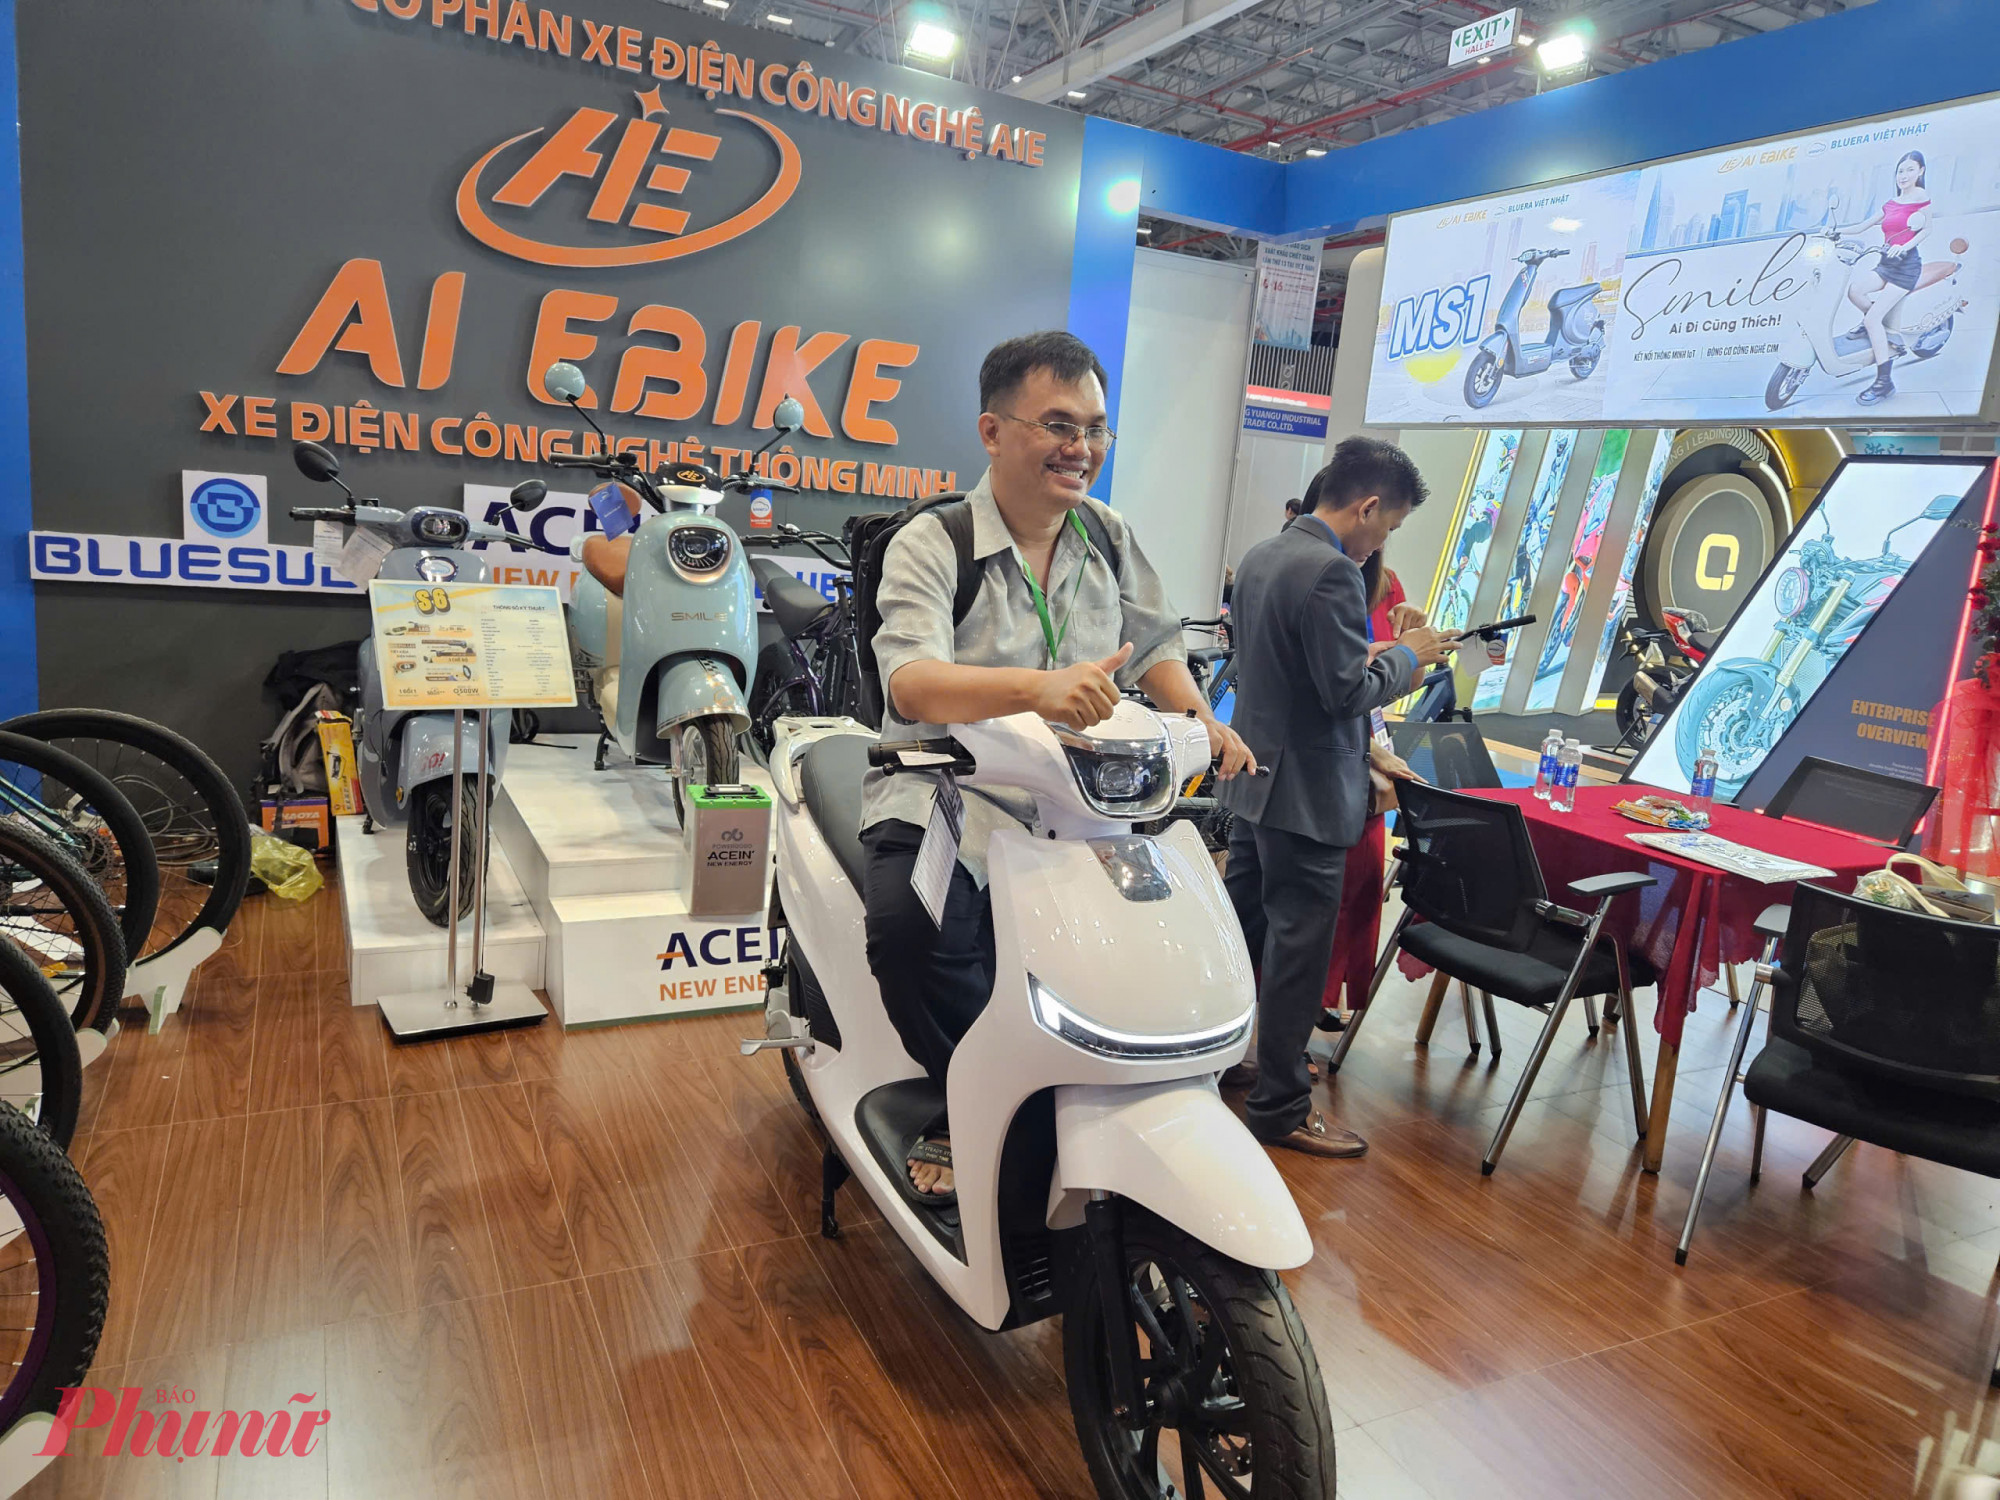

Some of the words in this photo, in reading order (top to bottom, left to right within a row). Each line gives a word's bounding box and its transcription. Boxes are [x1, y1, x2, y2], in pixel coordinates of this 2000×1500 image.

[1462, 17, 1502, 47] EXIT
[1465, 43, 1483, 55] HALL
[1485, 39, 1495, 49] B2
[581, 19, 643, 73] XE
[649, 39, 755, 100] ĐIỆN
[758, 60, 877, 127] CÔNG
[880, 92, 985, 161] NGHỆ
[987, 122, 1047, 168] AIE
[1759, 146, 1799, 165] EBIKE
[1830, 134, 1870, 150] BLUERA
[1873, 128, 1896, 143] VIỆT
[1898, 123, 1930, 137] NHẬT
[1508, 201, 1533, 213] BLUERA
[1534, 198, 1550, 209] VIỆT
[1550, 194, 1570, 206] NHẬT
[1624, 232, 1808, 340] Smile
[1389, 274, 1491, 360] MS1
[1669, 322, 1682, 335] Ai
[1685, 320, 1698, 333] Đi
[1702, 318, 1737, 332] Cũng
[1741, 314, 1782, 329] Thích!
[275, 257, 466, 391] AI
[526, 288, 921, 446] EBIKE
[1244, 417, 1266, 428] TRADE
[1251, 409, 1281, 420] YUANGU
[1281, 414, 1321, 426] INDUSTRIAL
[199, 390, 277, 438] XE
[291, 399, 420, 454] ĐIỆN
[430, 411, 574, 464] CÔNG
[861, 461, 957, 499] MINH
[1692, 428, 1733, 446] LEADING
[415, 588, 451, 615] S6
[671, 611, 728, 622] SMILE
[1851, 699, 1937, 727] ENTERPRISE
[1857, 722, 1930, 750] OVERVIEW
[656, 927, 779, 971] ACEI
[660, 979, 717, 1001] NEW
[724, 974, 768, 995] ENE
